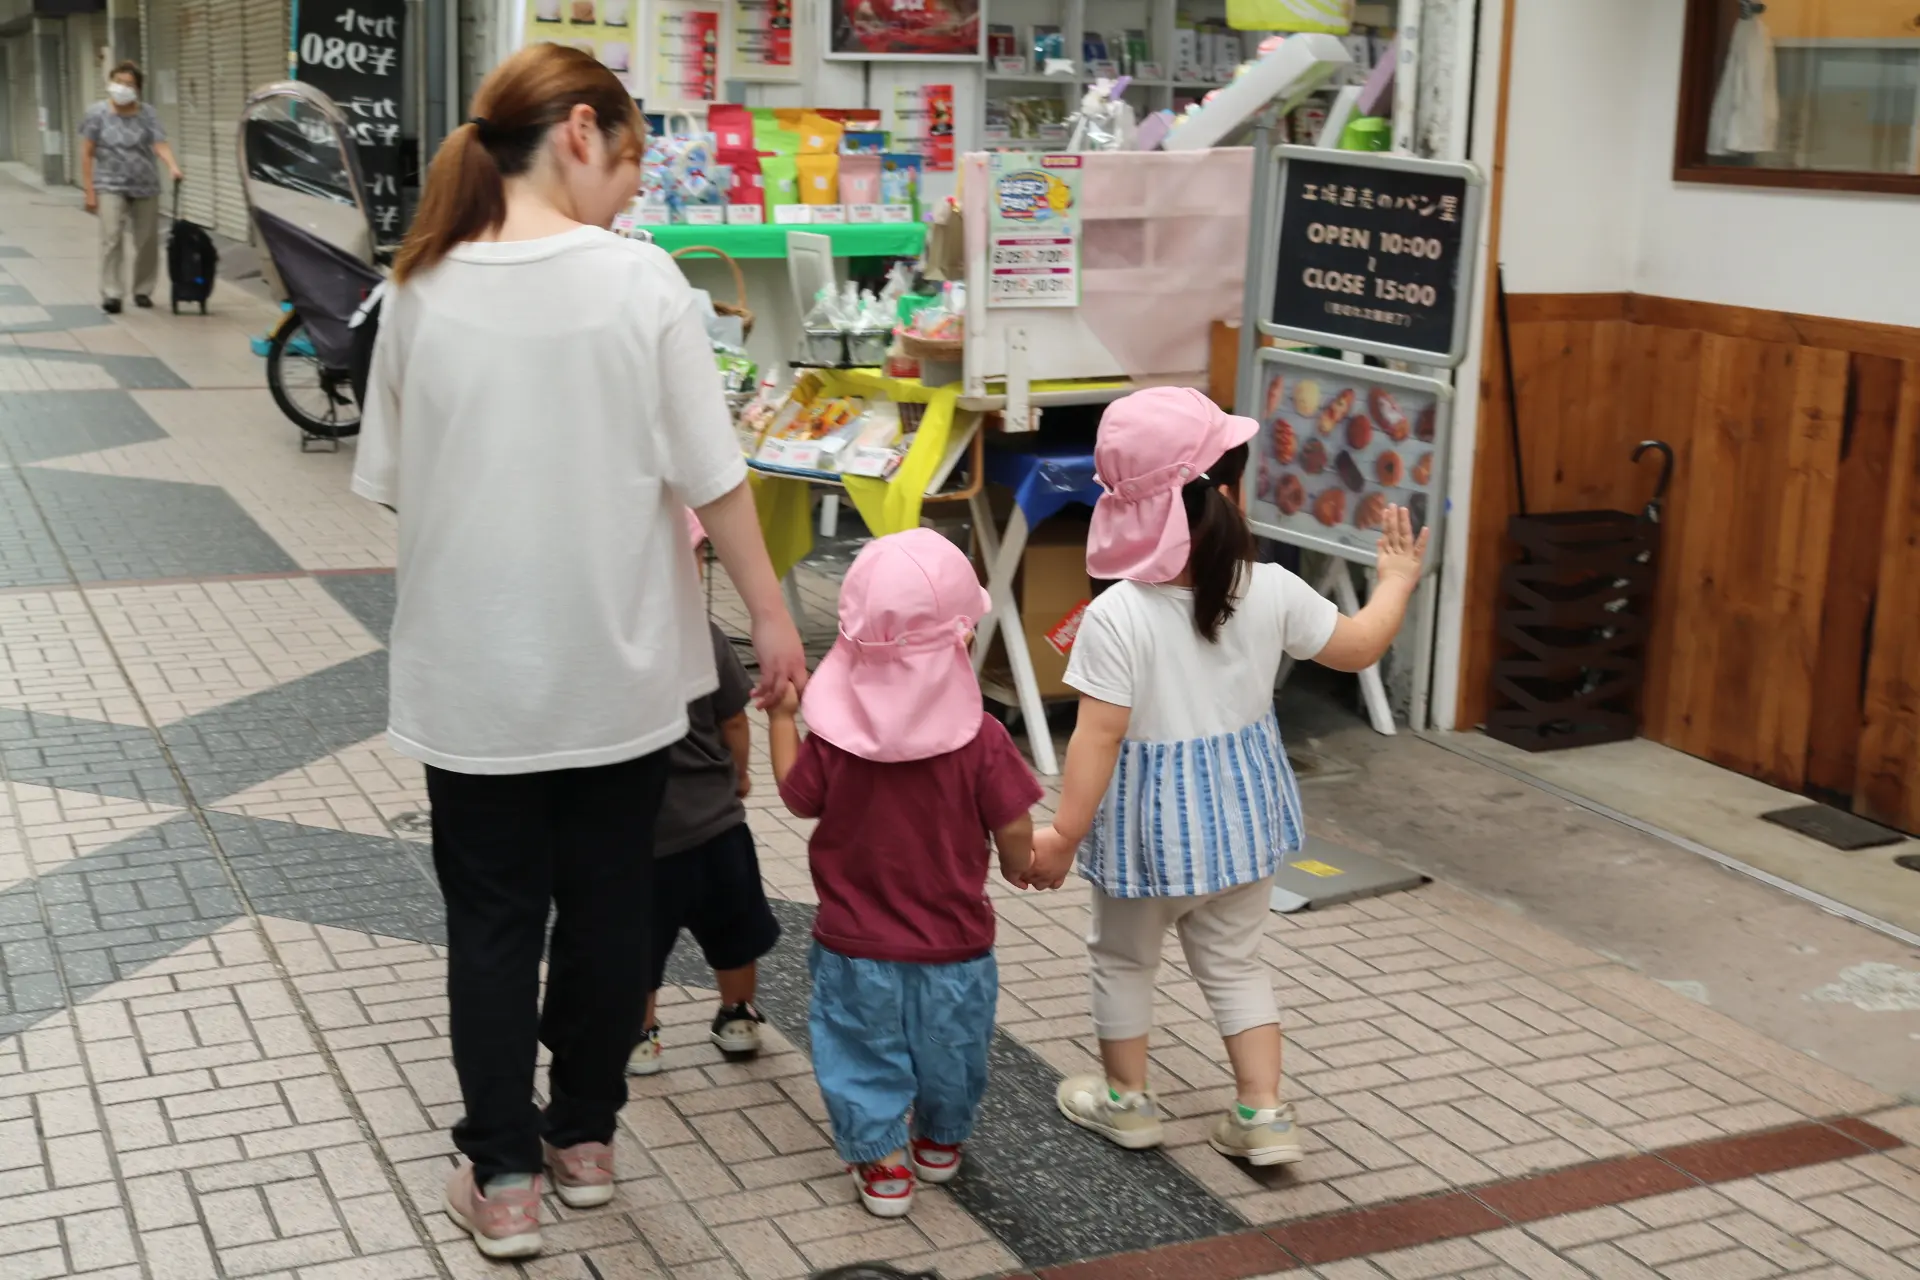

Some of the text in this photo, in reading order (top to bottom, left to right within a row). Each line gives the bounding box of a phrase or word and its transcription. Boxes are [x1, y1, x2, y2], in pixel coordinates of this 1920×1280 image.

[1307, 222, 1442, 260] OPEN 10:00
[1302, 267, 1436, 306] CLOSE 15:00
